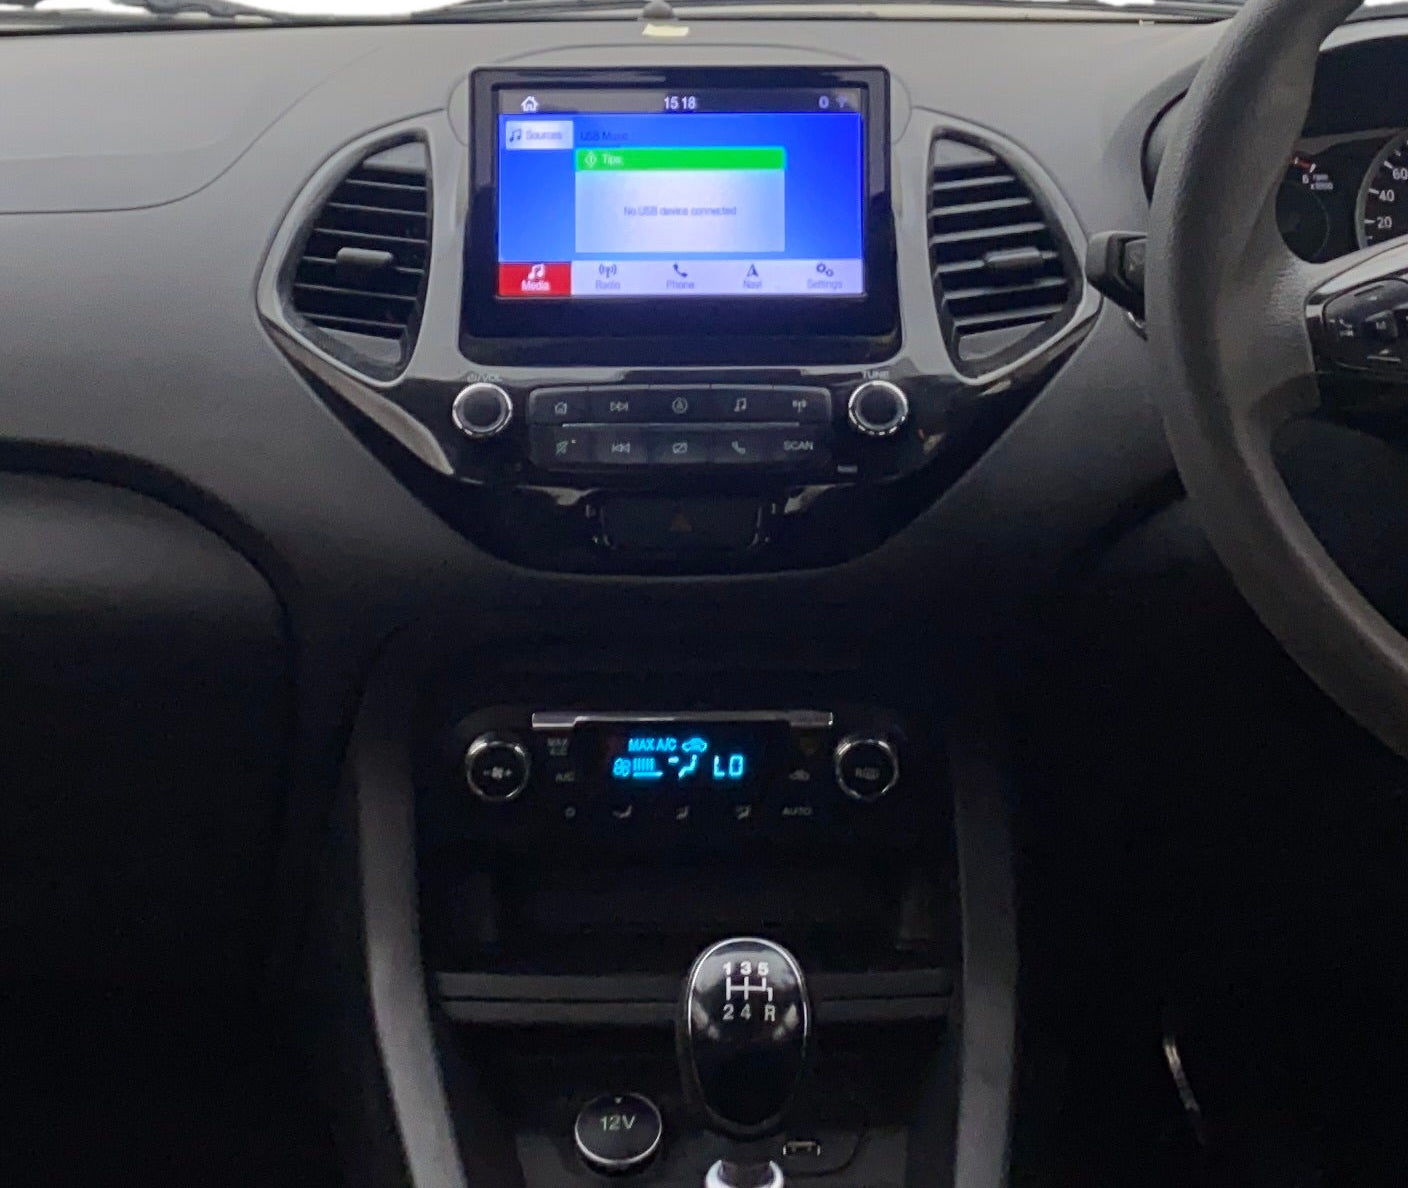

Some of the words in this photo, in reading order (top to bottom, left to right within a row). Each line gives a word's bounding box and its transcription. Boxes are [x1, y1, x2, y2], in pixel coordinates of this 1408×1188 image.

[525, 129, 562, 141] Sources
[1393, 168, 1408, 180] 60
[1379, 189, 1394, 202] 40
[624, 205, 636, 216] No
[638, 205, 658, 216] USB
[660, 205, 688, 216] device
[690, 205, 737, 216] connected
[1377, 217, 1392, 229] 20
[521, 280, 550, 291] Media
[596, 279, 620, 290] Radio
[666, 278, 695, 289] Phone
[743, 279, 762, 289] Navi
[807, 278, 843, 291] Settings
[783, 440, 814, 451] SCAN
[628, 738, 655, 751] MAX
[656, 738, 678, 751] A/C
[723, 961, 731, 976] 1
[739, 960, 752, 975] 3
[758, 961, 769, 976] 5
[722, 1003, 734, 1020] 2
[740, 1003, 752, 1019] 4
[764, 1004, 776, 1022] R
[600, 1114, 636, 1130] 12V
